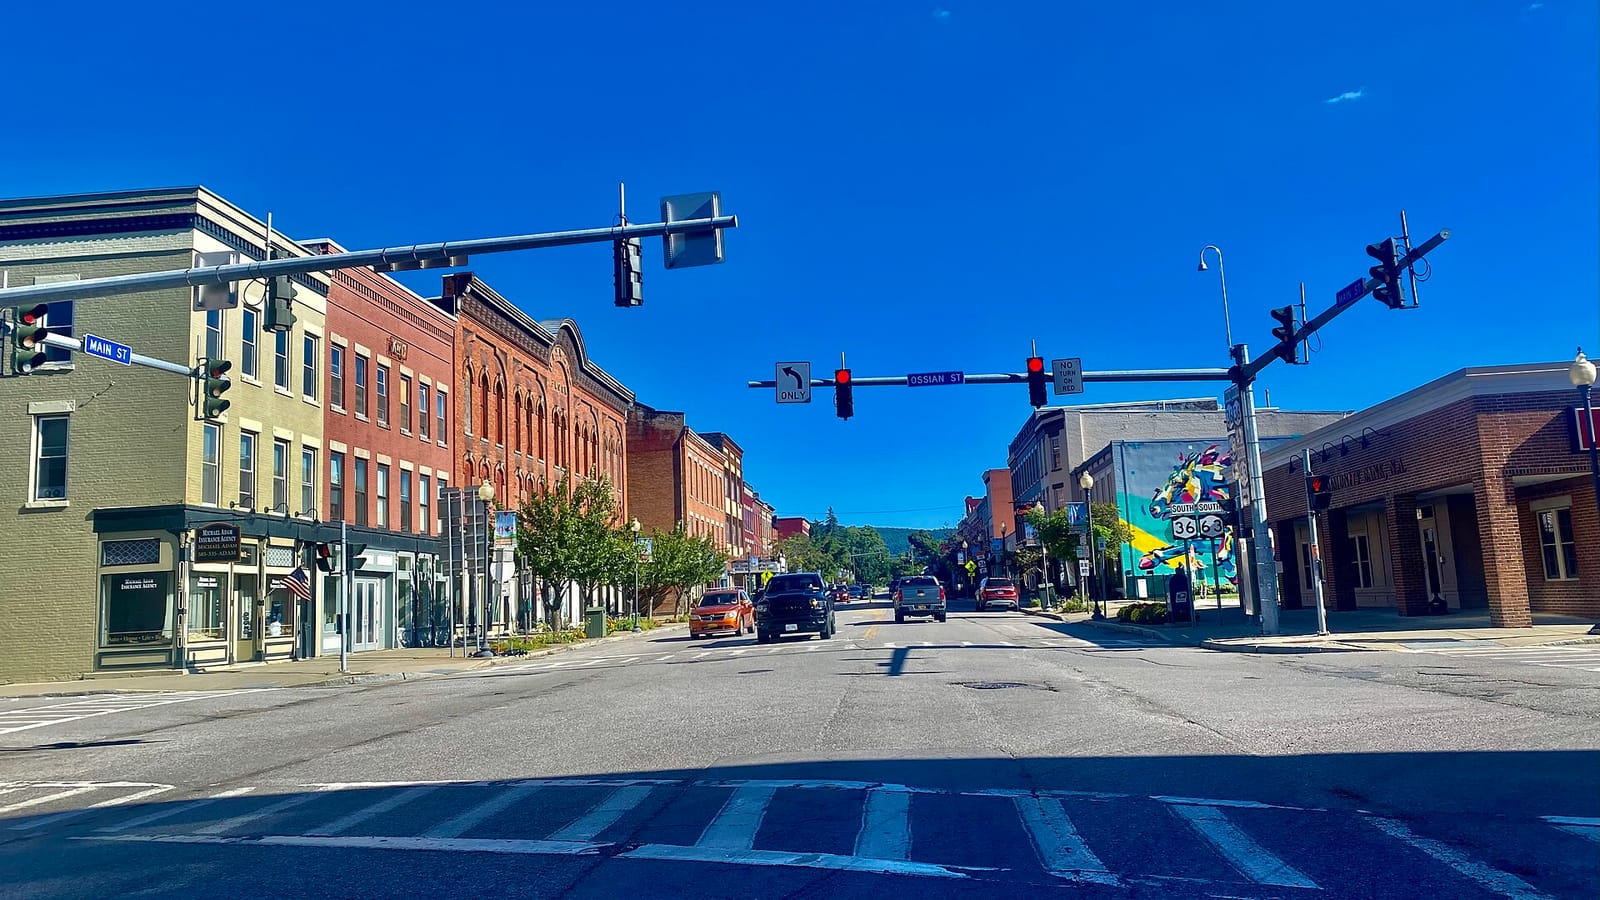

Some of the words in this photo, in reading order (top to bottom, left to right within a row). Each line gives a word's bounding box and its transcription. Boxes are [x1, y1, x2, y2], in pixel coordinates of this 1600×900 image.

[90, 339, 112, 355] MAIN
[116, 347, 127, 360] ST
[1060, 361, 1073, 369] NO
[910, 375, 945, 384] OSSIAN
[950, 373, 961, 382] ST
[781, 391, 806, 400] ONLY
[1172, 504, 1194, 513] SOUTH
[1175, 521, 1195, 534] 36
[1202, 520, 1222, 533] 63
